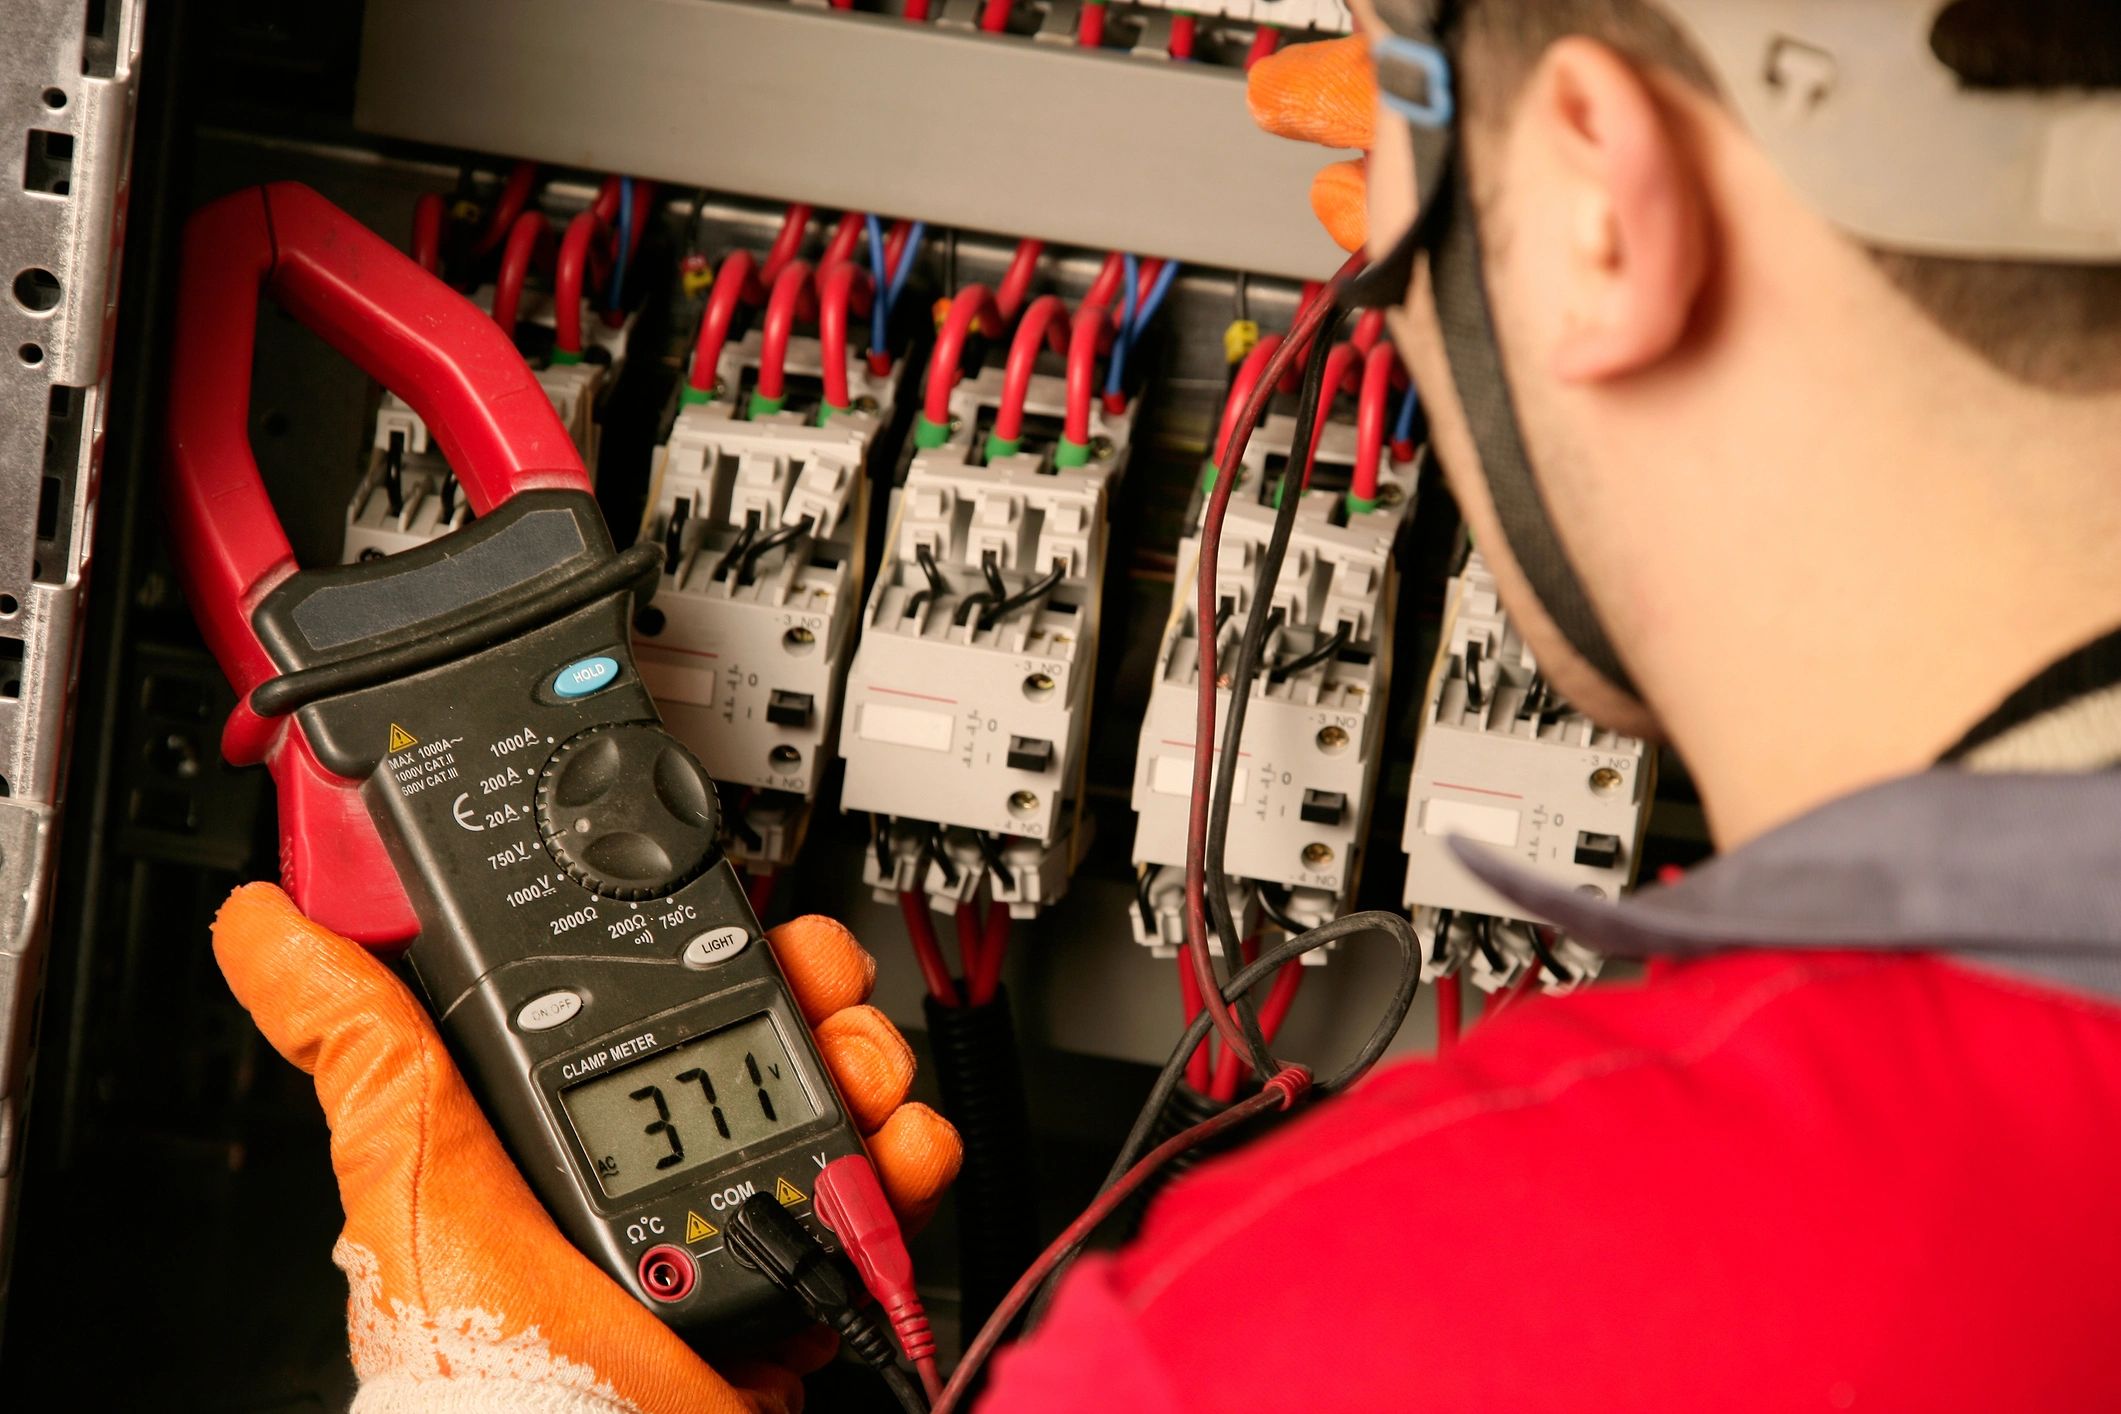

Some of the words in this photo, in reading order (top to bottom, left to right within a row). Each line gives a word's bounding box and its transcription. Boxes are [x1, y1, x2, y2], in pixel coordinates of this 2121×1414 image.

[572, 663, 605, 684] HOLD
[491, 727, 537, 758] 1000A
[388, 752, 415, 770] MAX
[395, 764, 423, 783] 1000V
[424, 753, 455, 772] CAT.II
[401, 779, 425, 797] 600V
[480, 766, 520, 795] 200A
[485, 803, 519, 829] 20A
[487, 841, 527, 870] 750V
[506, 875, 553, 908] 1000V
[550, 906, 599, 936] 2000Ω
[607, 914, 648, 940] 200Ω
[658, 905, 697, 930] 750°C
[701, 934, 735, 954] LIGHT
[562, 1052, 608, 1080] CLAMP
[609, 1032, 658, 1062] METER
[628, 1051, 777, 1170] 371
[768, 1063, 781, 1080] V
[598, 1155, 617, 1172] AC
[710, 1180, 756, 1211] COM
